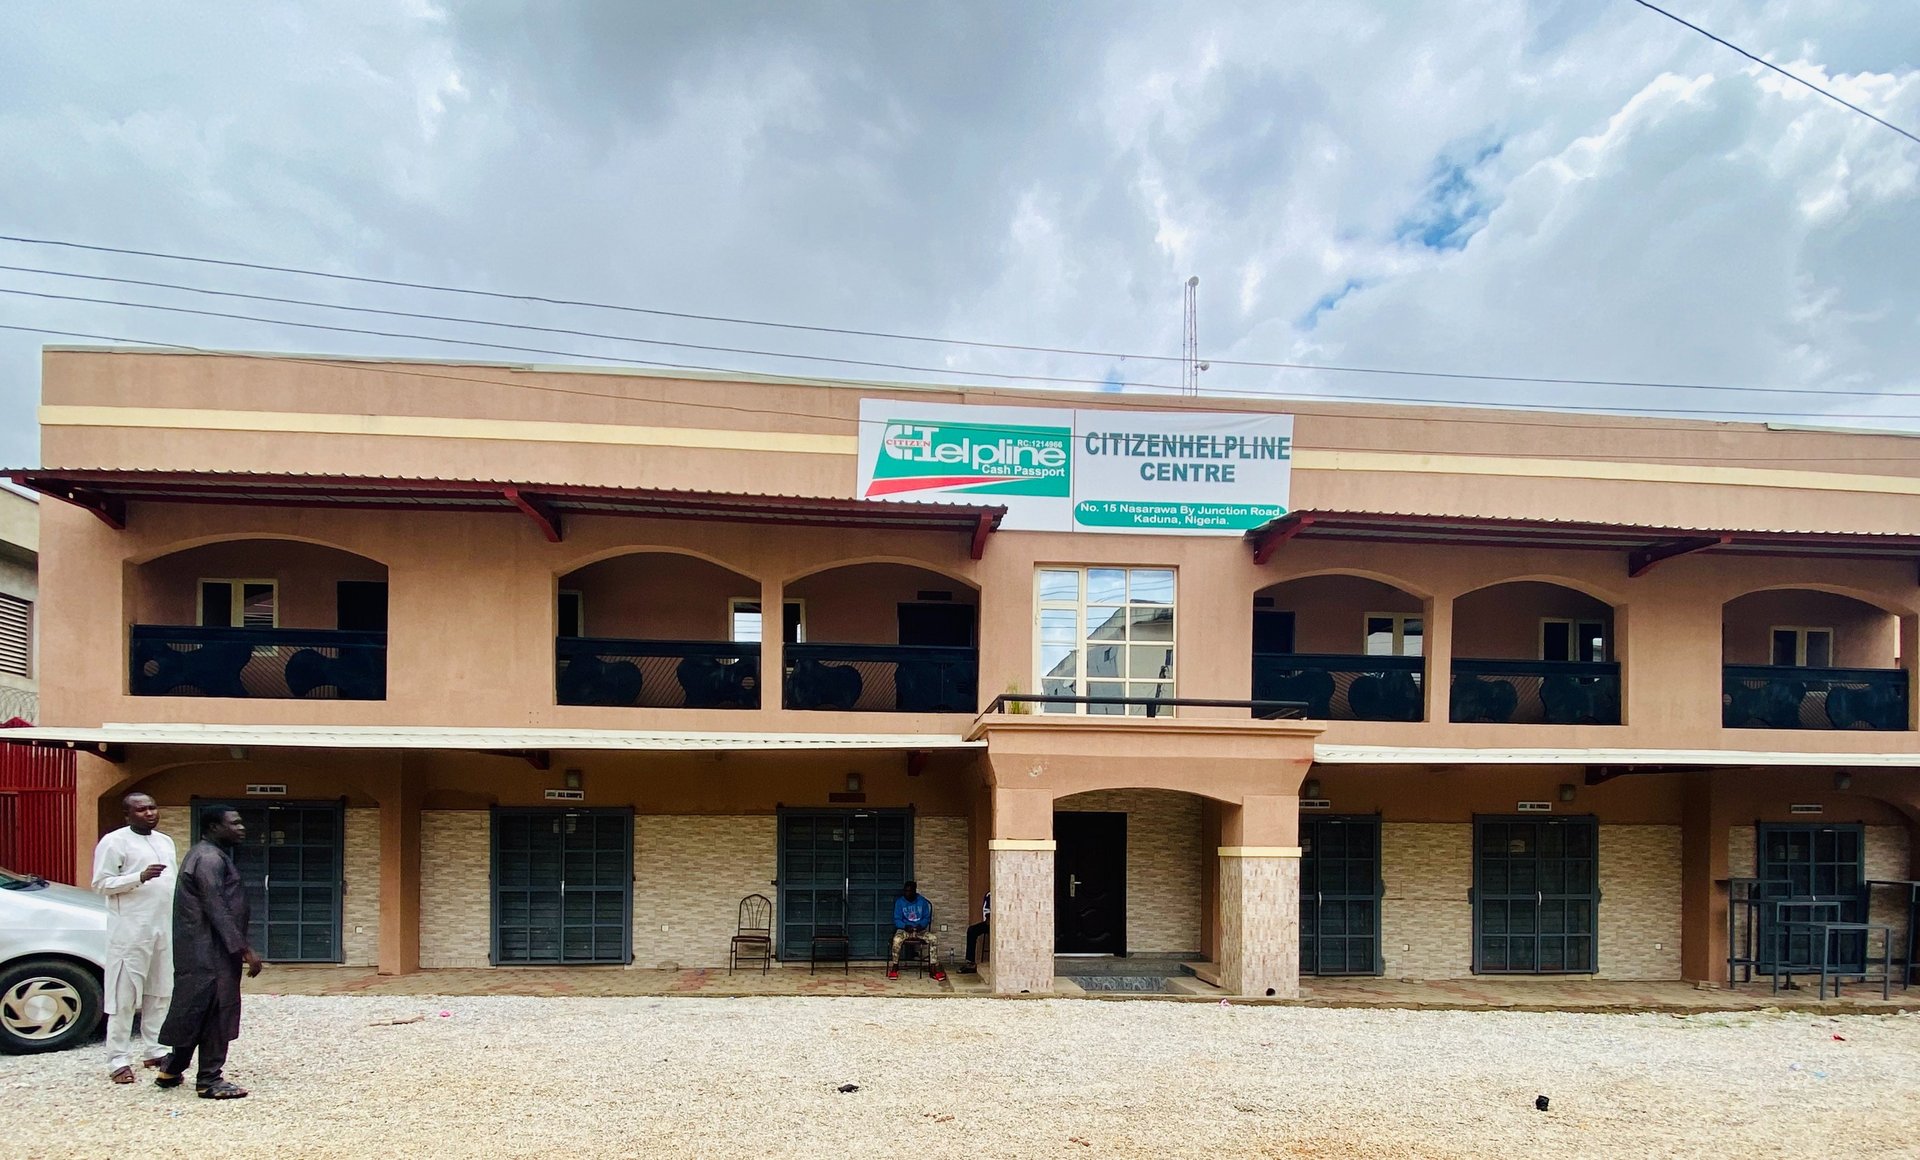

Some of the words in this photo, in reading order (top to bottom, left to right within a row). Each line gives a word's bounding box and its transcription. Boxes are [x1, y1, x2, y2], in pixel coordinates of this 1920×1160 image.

[885, 439, 931, 448] CITIZEN
[1085, 431, 1291, 460] CITIZENHELPLINE
[982, 465, 1011, 475] Cash
[1014, 466, 1065, 478] Passport
[1140, 462, 1236, 483] CENTRE
[1080, 503, 1099, 512] No.
[1103, 503, 1117, 512] 15
[1120, 504, 1178, 514] Nasarawa
[1180, 505, 1195, 516] By
[1197, 506, 1248, 516] Junction
[1134, 514, 1182, 525] Kaduna,
[1185, 516, 1230, 527] Nigeria.
